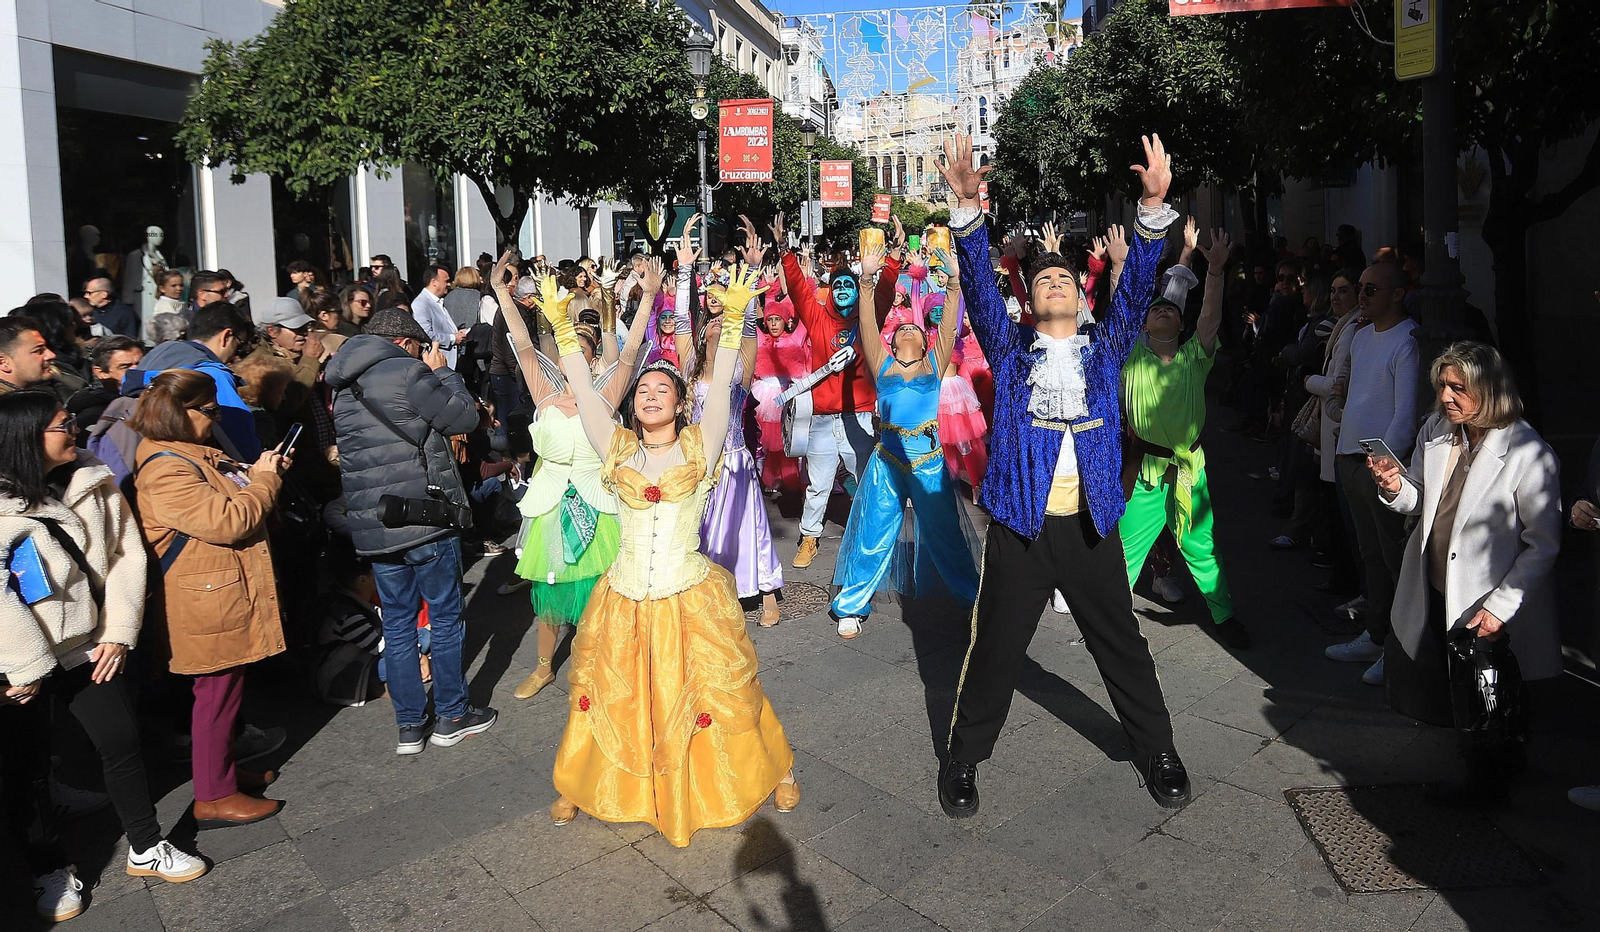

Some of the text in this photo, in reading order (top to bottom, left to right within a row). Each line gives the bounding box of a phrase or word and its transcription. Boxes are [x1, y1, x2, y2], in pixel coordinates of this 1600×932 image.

[723, 126, 768, 137] ZAMBOMBAS
[747, 137, 769, 147] 2024
[719, 169, 773, 180] Cruzcampo
